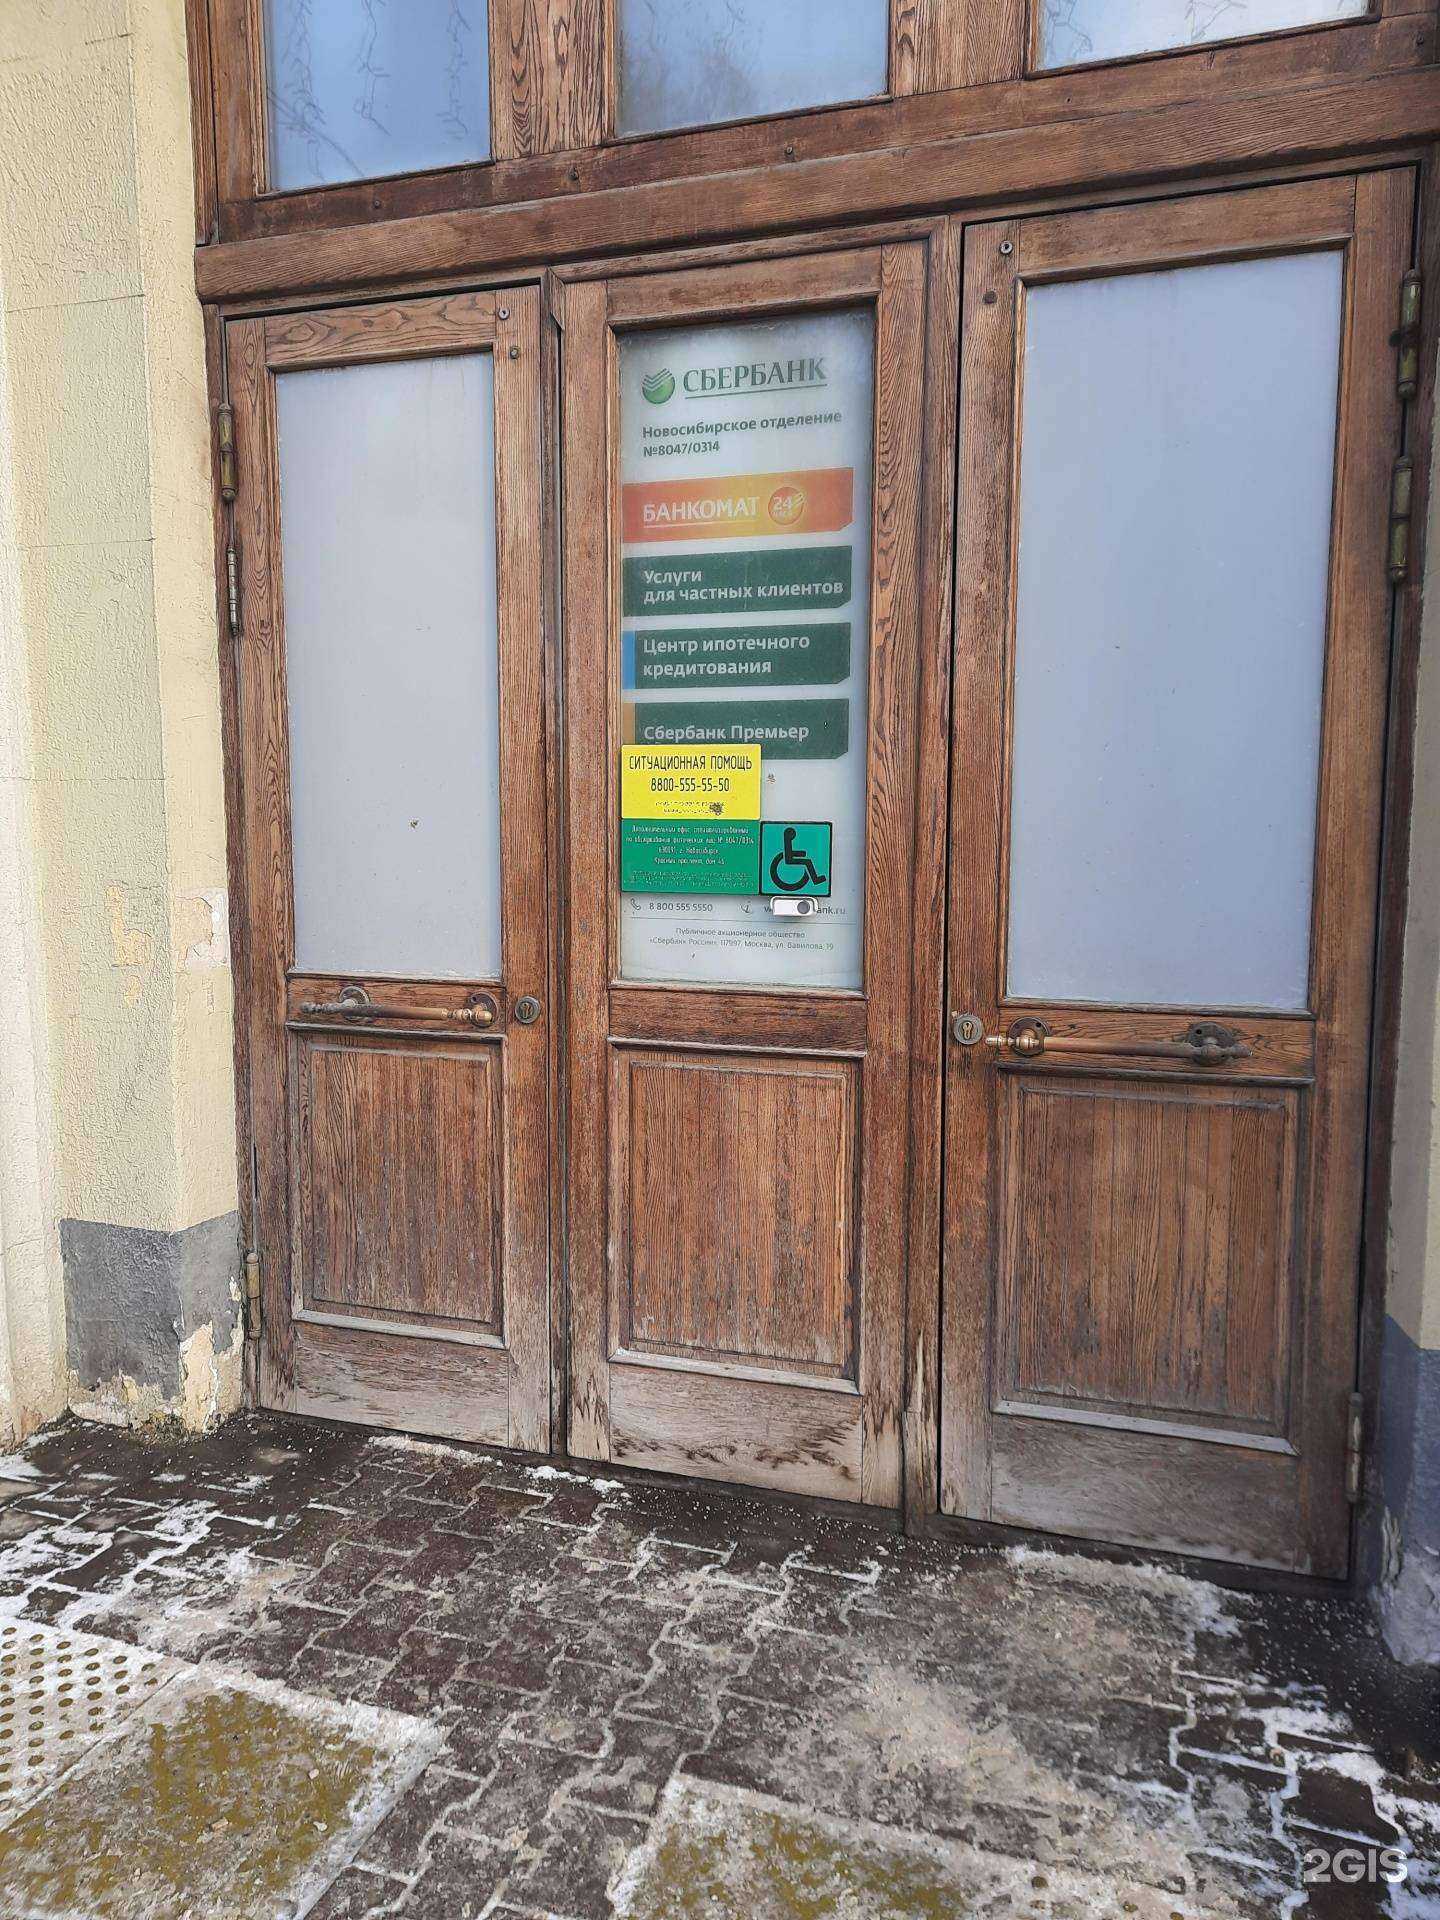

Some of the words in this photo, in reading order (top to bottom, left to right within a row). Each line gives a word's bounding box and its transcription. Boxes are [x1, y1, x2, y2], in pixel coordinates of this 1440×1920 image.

[683, 358, 827, 392] СБЕРБАНК
[643, 419, 757, 439] Новосибирское
[760, 412, 842, 430] отделение
[643, 440, 720, 457] №8047/0314
[644, 496, 760, 522] БАНКОМАТ
[773, 496, 792, 511] 24
[644, 570, 702, 586] Услуги
[644, 589, 675, 605] для
[680, 584, 753, 600] частных
[757, 582, 844, 597] клиентов
[644, 638, 698, 655] Центр
[703, 636, 810, 652] ипотечного
[643, 660, 772, 678] кредитования
[644, 725, 726, 742] Сбербанк
[730, 725, 809, 742] Премьер
[629, 755, 706, 771] СИТУАЦИОННАЯ
[710, 755, 752, 771] ПОМОЩЬ
[651, 778, 730, 792] 8800-555-55-50
[649, 902, 654, 910] 8
[657, 902, 674, 911] 800
[676, 902, 690, 911] 555
[692, 903, 713, 912] 5550
